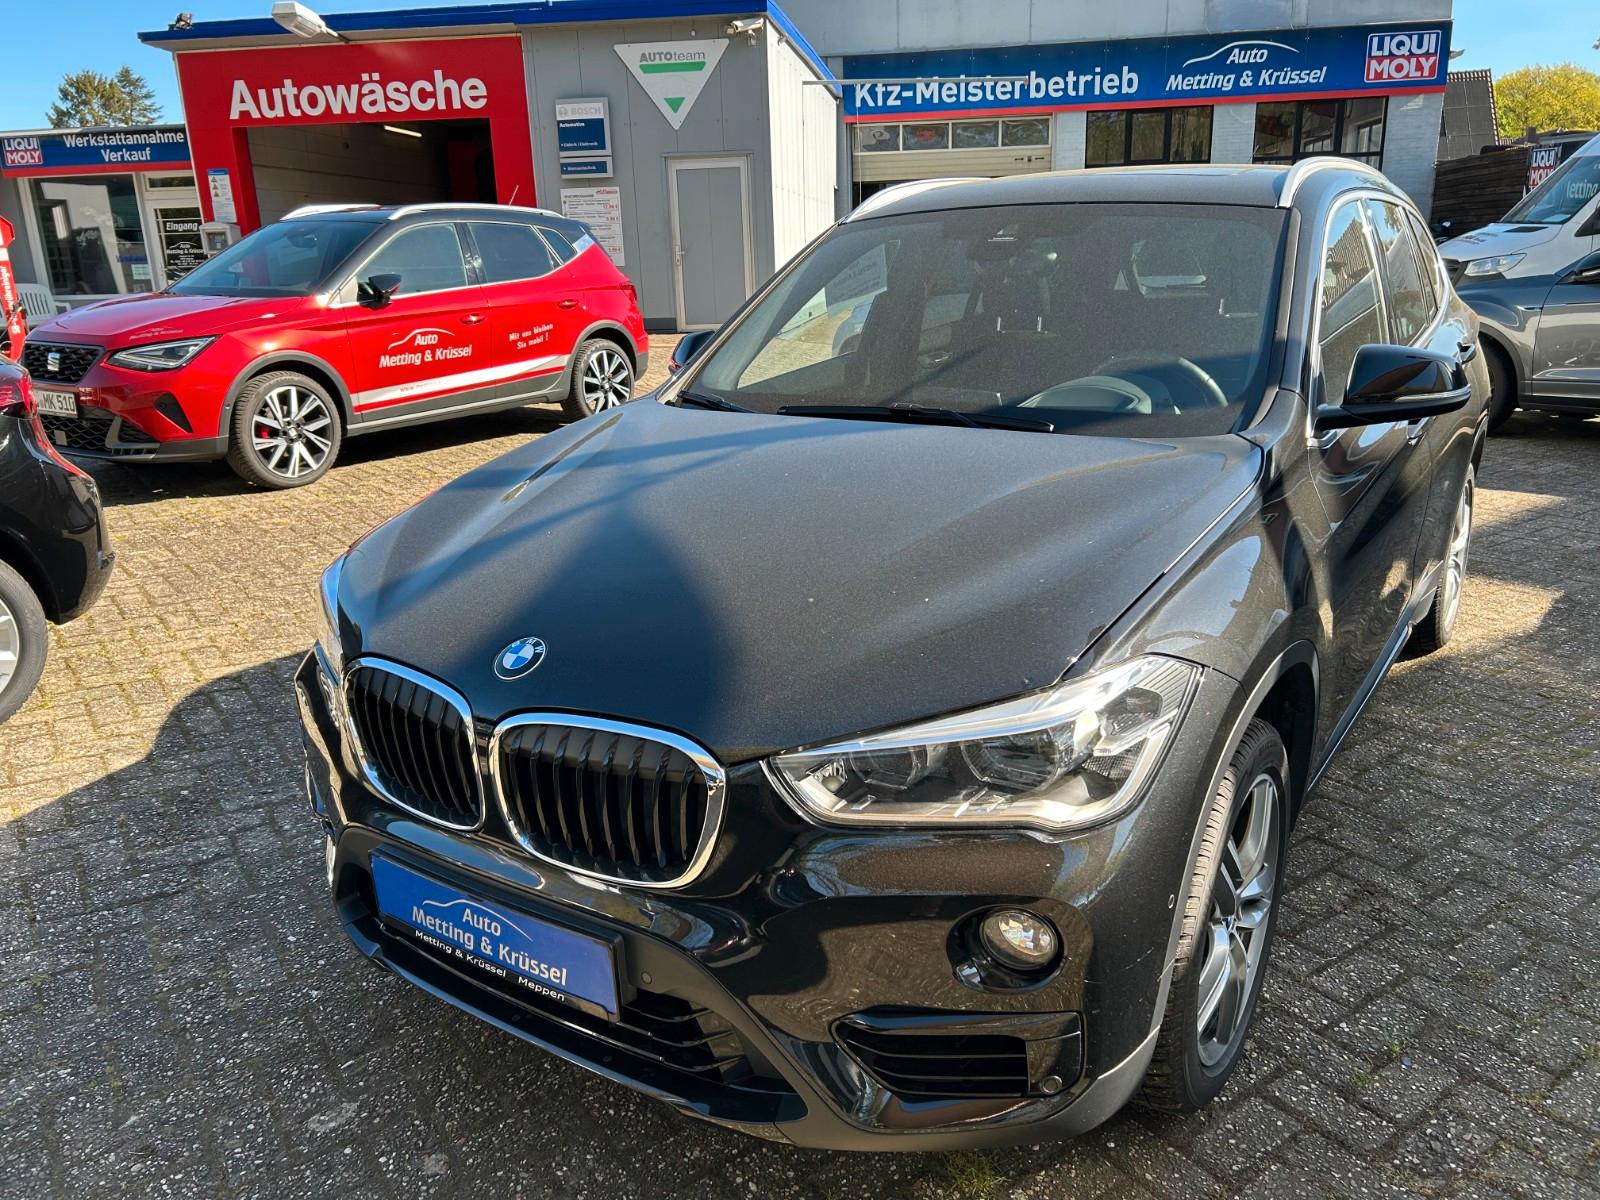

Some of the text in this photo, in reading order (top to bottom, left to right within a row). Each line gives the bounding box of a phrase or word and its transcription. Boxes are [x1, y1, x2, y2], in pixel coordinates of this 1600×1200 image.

[1371, 33, 1436, 57] LIQUI
[640, 51, 705, 62] AUTOteam
[1226, 47, 1268, 64] Auto
[1368, 57, 1437, 79] MOLY
[854, 66, 1139, 108] Kfz-Meisterbetrieb
[1165, 66, 1328, 92] Metting & Krüssel
[229, 69, 488, 120] Autowäsche
[571, 106, 602, 116] BOSCH
[4, 137, 38, 151] LIQUI
[63, 131, 184, 148] Werkstattannahme
[6, 151, 41, 164] MOLY
[101, 148, 151, 162] Verkauf
[1532, 150, 1555, 167] LIQUI
[166, 222, 198, 231] Eingang
[414, 333, 439, 346] Auto
[378, 344, 472, 368] Metting & Krüssel
[43, 393, 76, 412] MK 510
[462, 908, 501, 937] Auto
[412, 905, 567, 986] Metting & Krüssel
[415, 930, 565, 1002] Metting & Krüssel Meppen
